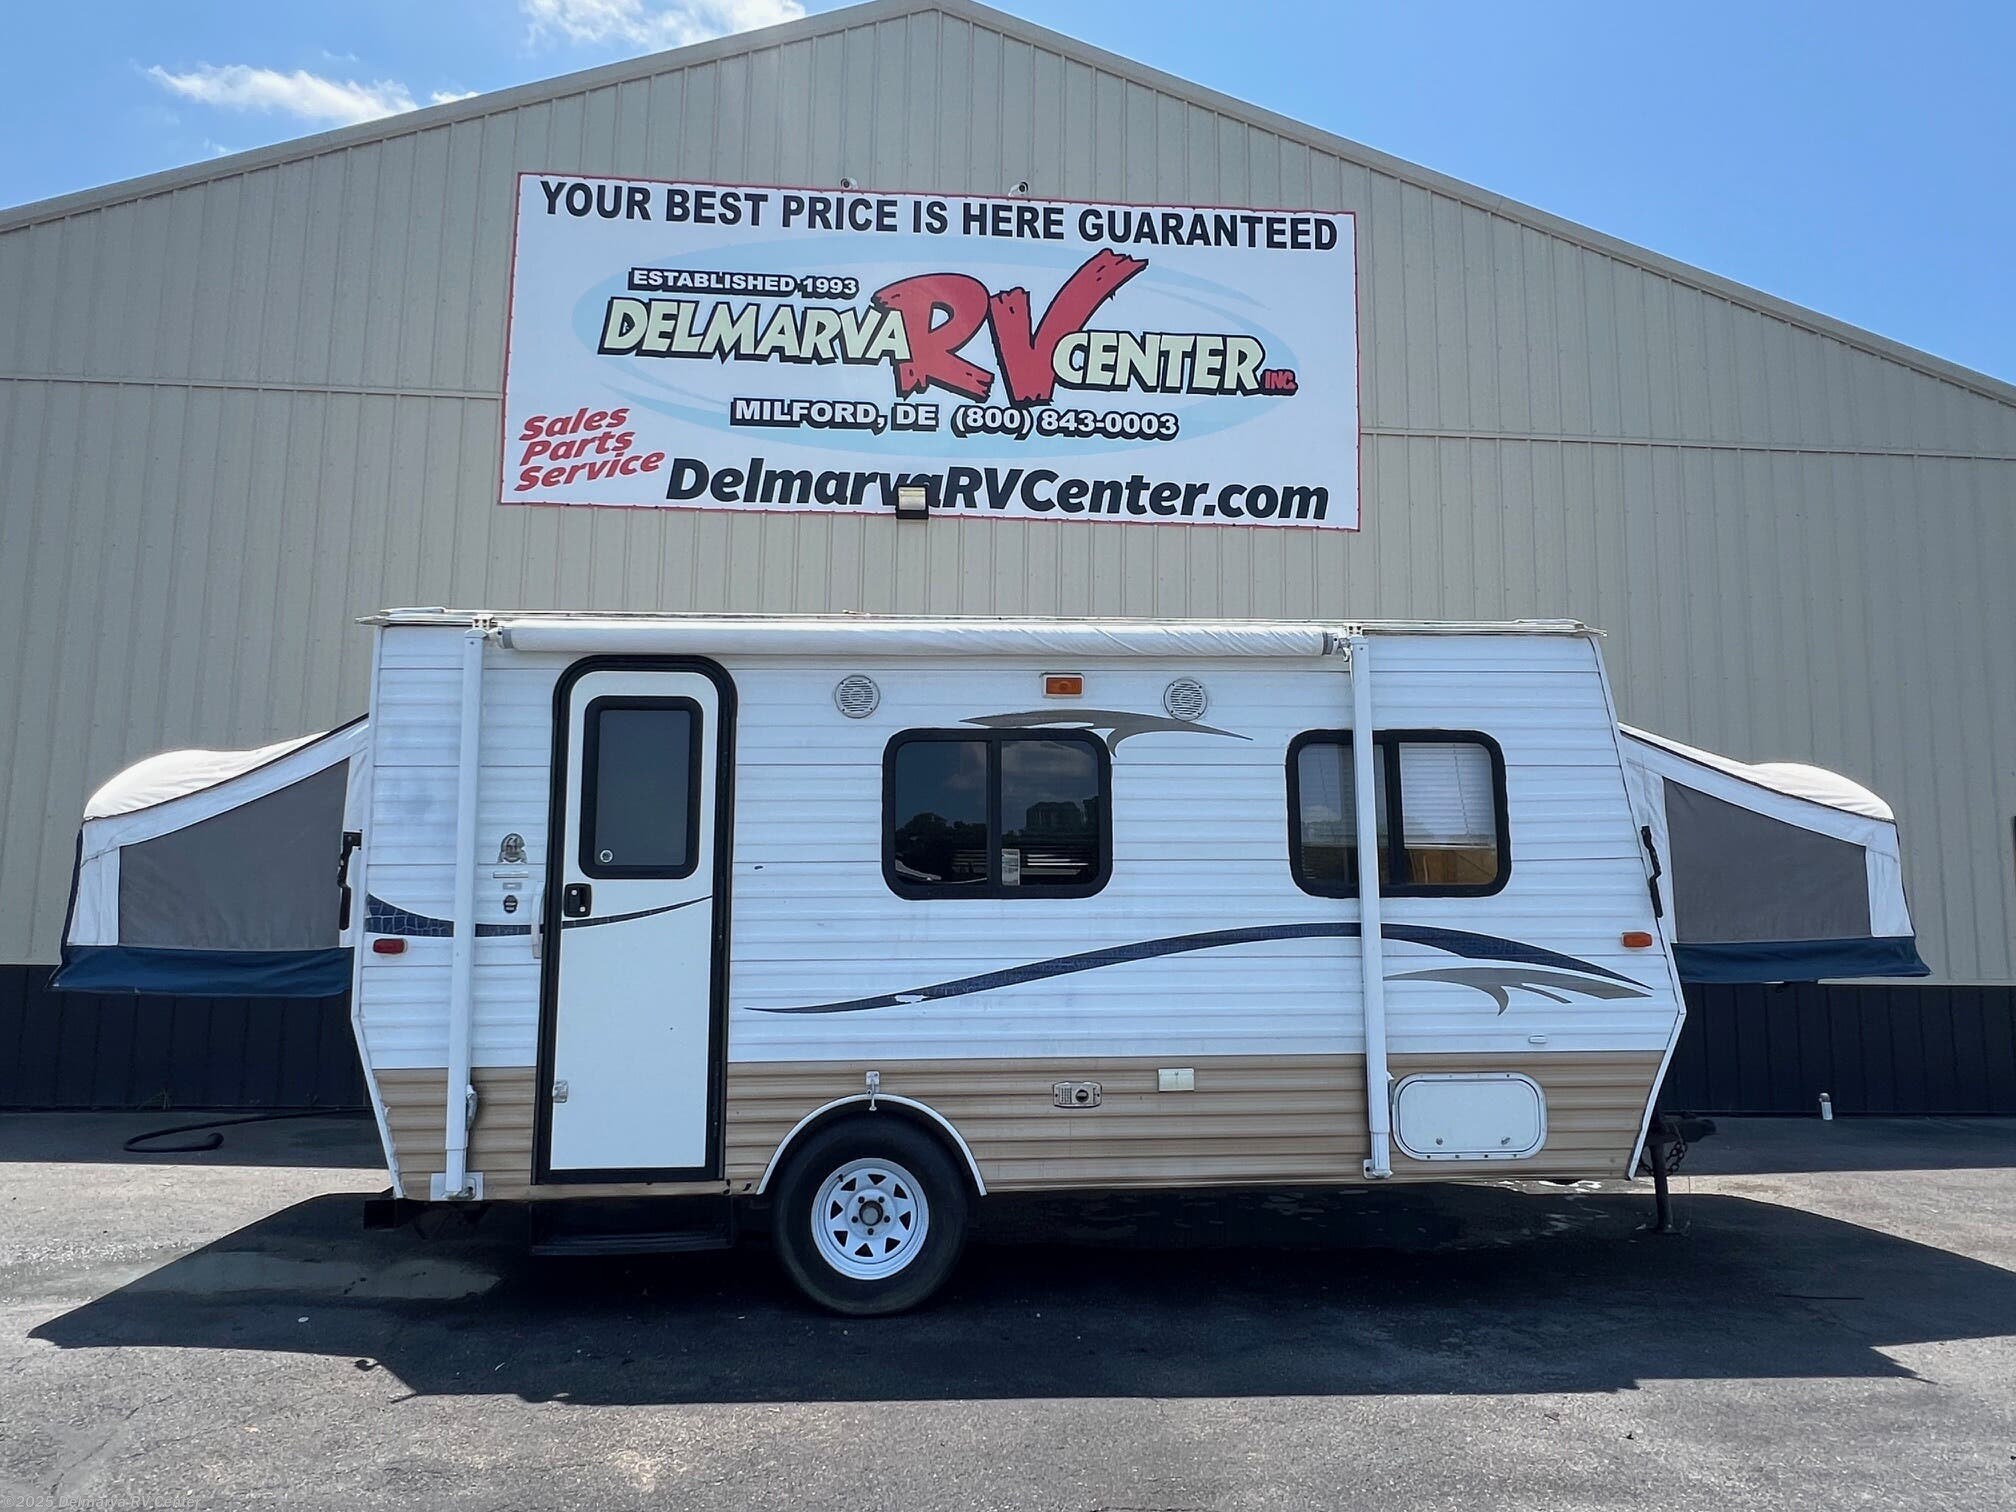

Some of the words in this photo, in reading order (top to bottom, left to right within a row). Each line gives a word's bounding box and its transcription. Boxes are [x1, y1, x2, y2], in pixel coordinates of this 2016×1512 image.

[541, 180, 651, 221] YOUR
[665, 190, 769, 227] BEST
[782, 195, 898, 232] PRICE
[913, 200, 948, 234] IS
[962, 201, 1065, 240] HERE
[1078, 208, 1338, 250] GUARANTEED
[632, 269, 796, 294] ESTABLISHED
[801, 276, 858, 295] 1993
[600, 298, 911, 363] DELMARVA
[873, 248, 1149, 404] RV
[1053, 331, 1266, 393] CENTER
[519, 407, 630, 441] Sales
[734, 400, 887, 432] MILFORD,
[896, 404, 938, 428] DE
[955, 406, 1032, 437] (800)
[1041, 410, 1178, 437] 843-0003
[519, 428, 635, 466] Parts
[514, 451, 666, 492] Service
[666, 457, 1330, 520] DelmarvaRVCenter.com
